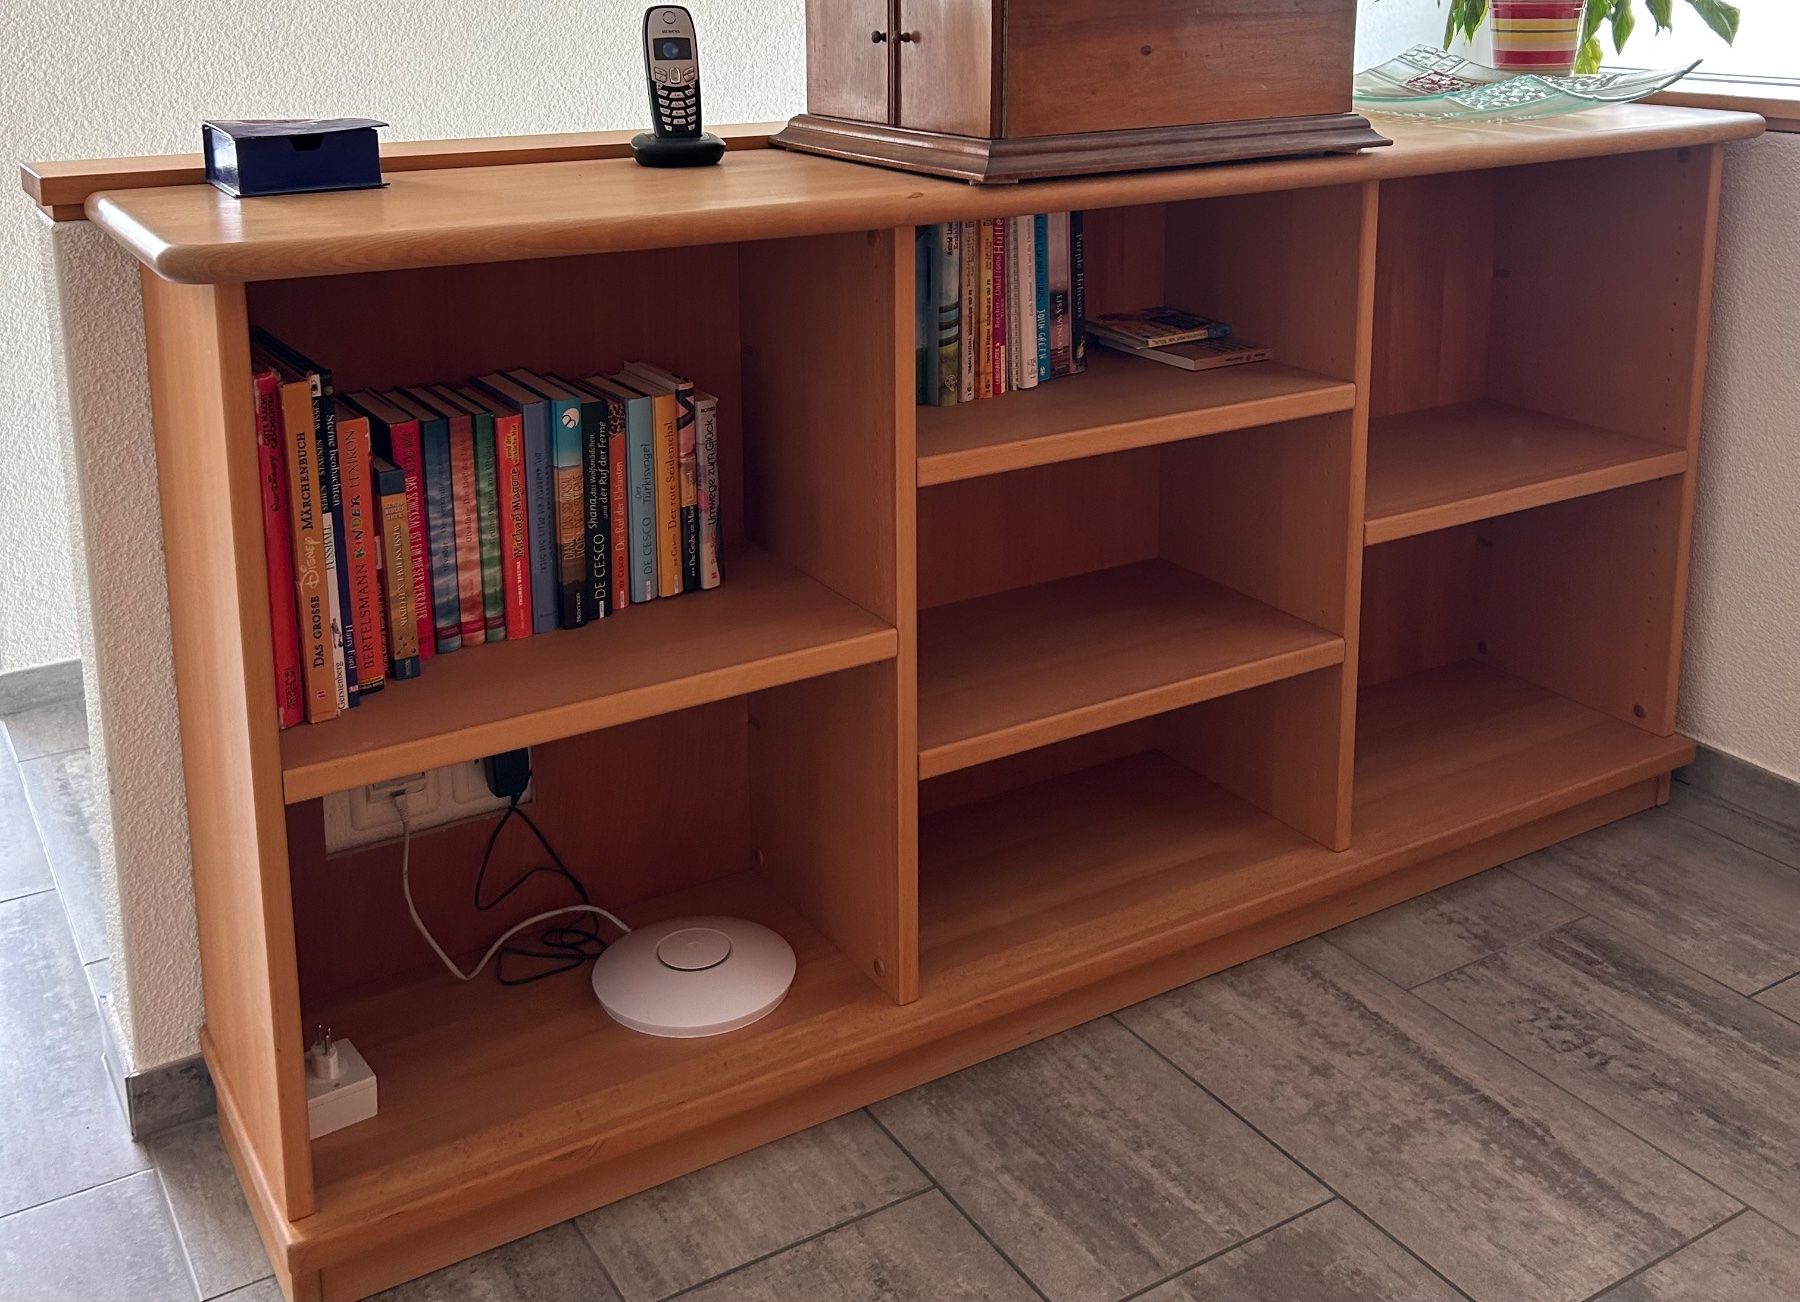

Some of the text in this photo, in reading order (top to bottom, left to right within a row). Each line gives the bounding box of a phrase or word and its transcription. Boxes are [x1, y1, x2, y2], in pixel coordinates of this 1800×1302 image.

[1075, 233, 1084, 268] Purple
[1037, 309, 1046, 330] JOHN
[1038, 332, 1046, 359] GREEN
[312, 398, 321, 430] WISSEN
[598, 421, 606, 448] Ferne
[704, 419, 715, 451] Glück
[315, 439, 325, 476] STAUNEN
[325, 414, 342, 506] Sterne beobachten
[344, 430, 360, 488] LEXIKON
[598, 450, 606, 466] der
[664, 421, 674, 482] Seidenschal
[706, 453, 715, 475] zum
[296, 432, 314, 530] MÄRCHENBUCH
[406, 476, 419, 492] DAS
[511, 467, 523, 511] Magone
[599, 468, 609, 484] Ruf
[613, 461, 623, 500] Elefanten
[599, 488, 607, 503] der
[706, 478, 717, 526] Umwege
[407, 493, 423, 530] SCHICKSAL
[615, 503, 623, 516] der
[668, 509, 677, 529] Der
[410, 531, 423, 542] IST
[615, 518, 624, 532] Ruf
[642, 517, 651, 556] CESCO
[323, 523, 334, 571] FUSSBALL
[411, 544, 424, 557] EIN
[593, 534, 605, 578] CESCO
[616, 536, 625, 551] Der
[413, 557, 426, 582] MIESER
[643, 562, 652, 574] DE
[594, 582, 606, 599] DE
[619, 580, 624, 588] DE
[309, 595, 322, 639] GROSSE
[356, 563, 375, 669] BERTELSMANN
[312, 643, 325, 668] DAS
[333, 661, 346, 710] Gerstenberg
